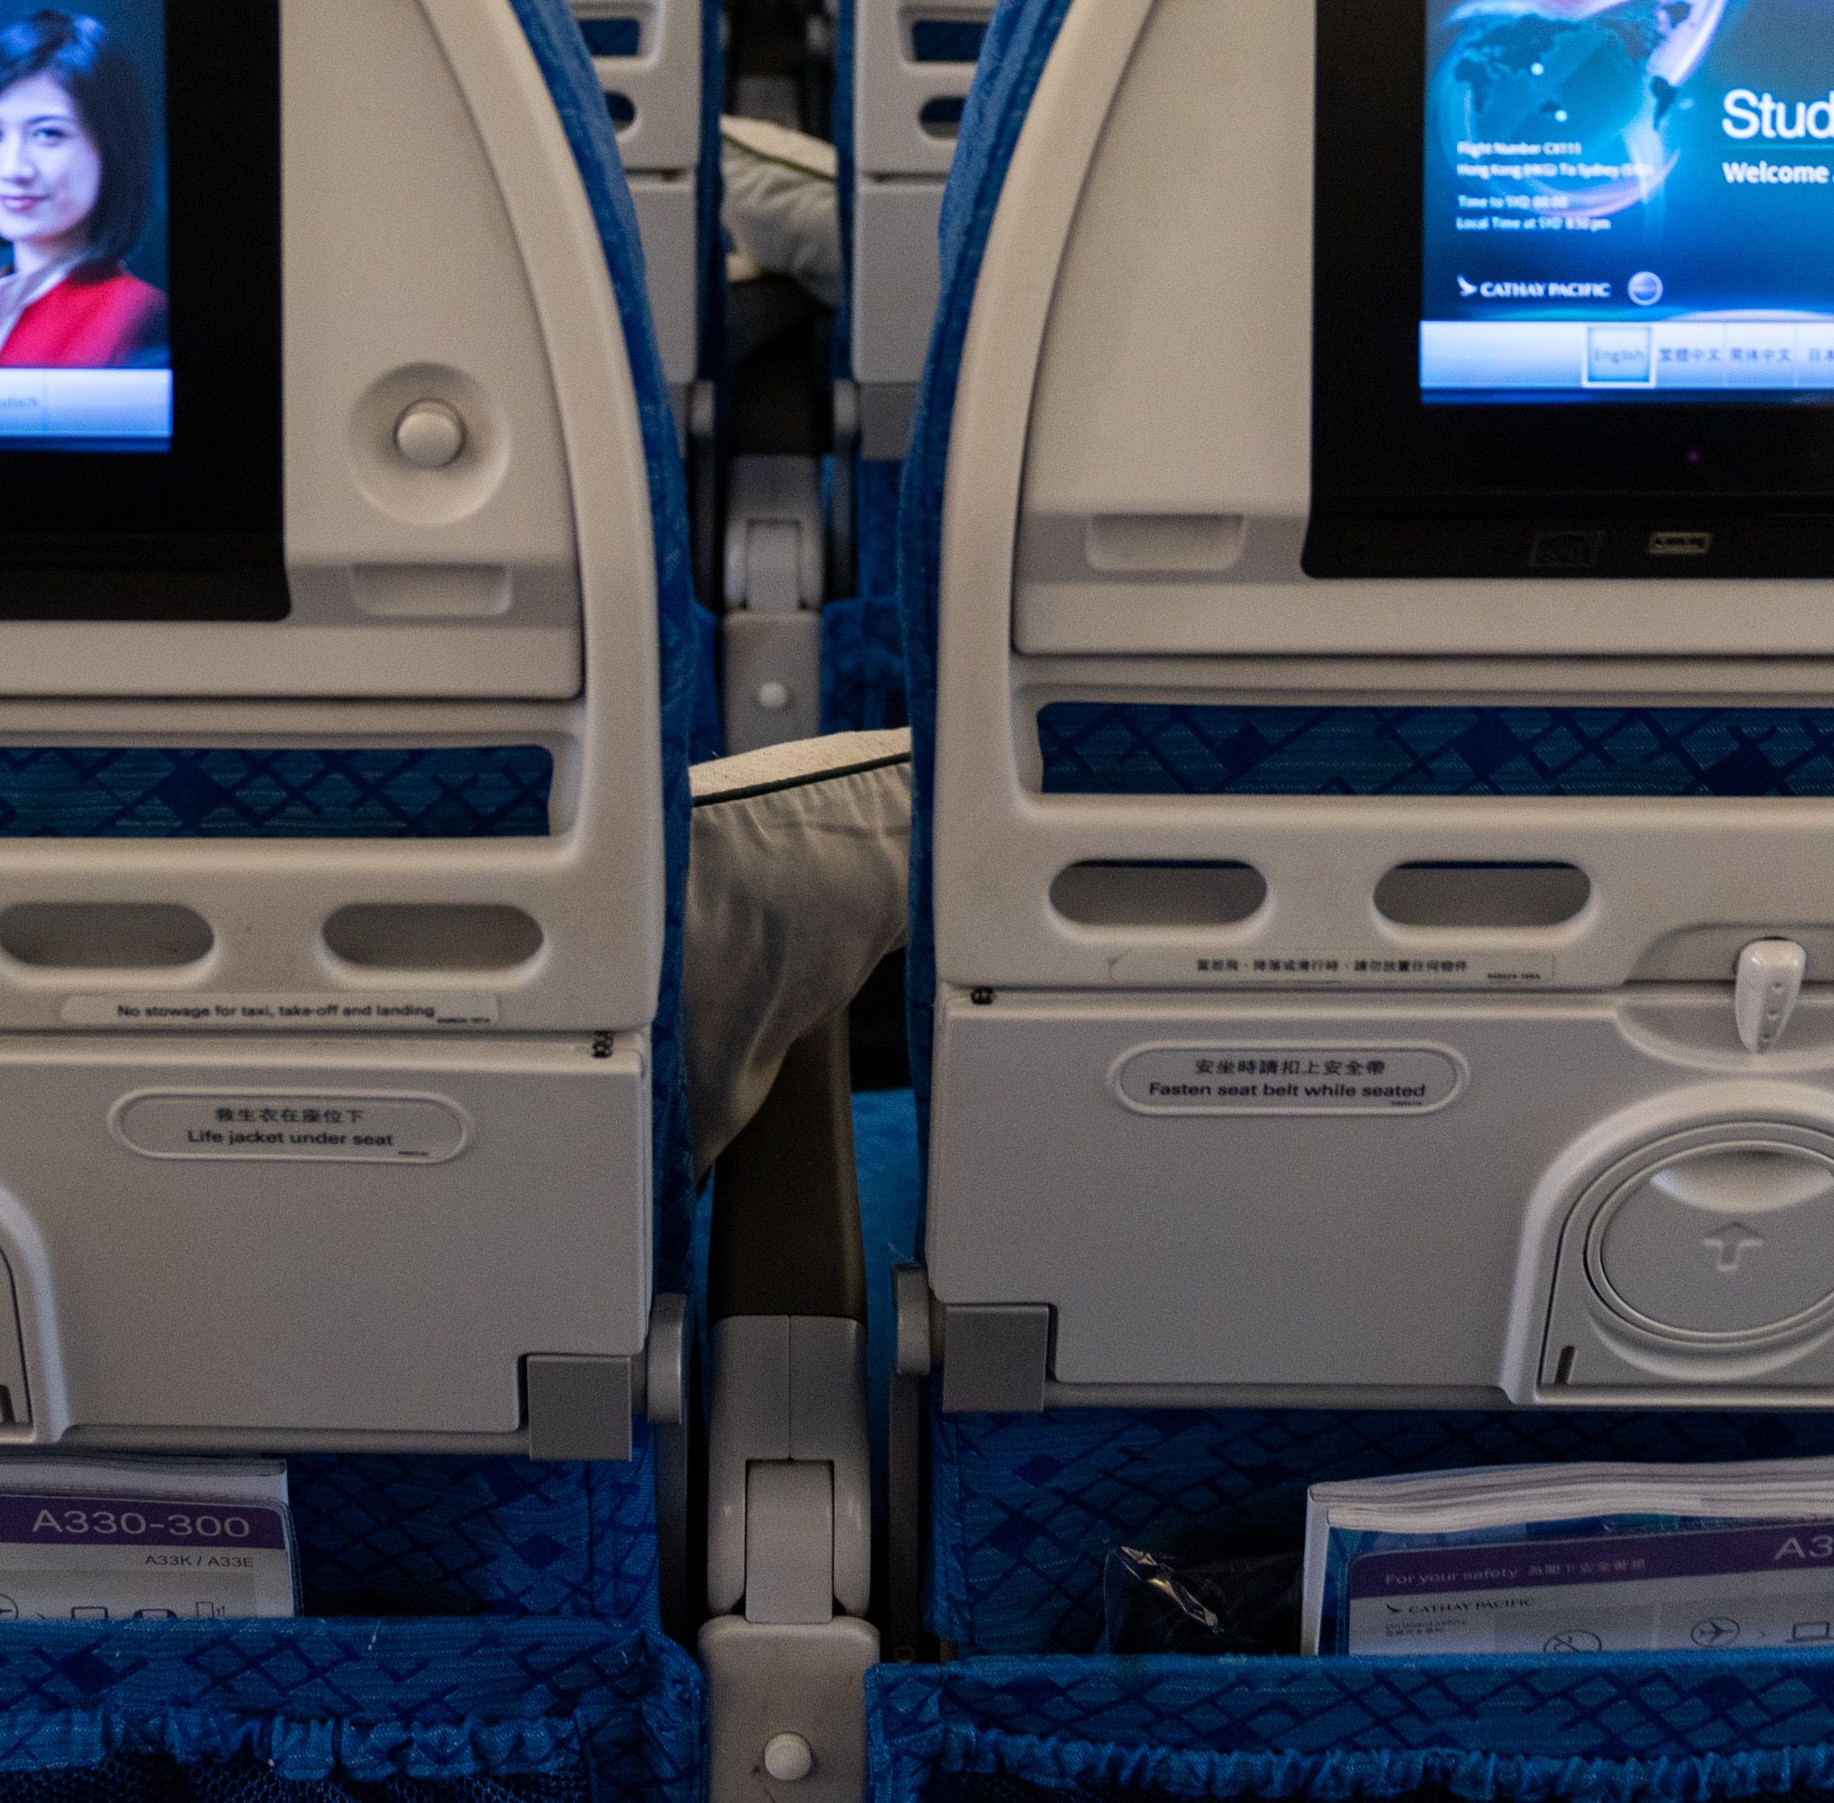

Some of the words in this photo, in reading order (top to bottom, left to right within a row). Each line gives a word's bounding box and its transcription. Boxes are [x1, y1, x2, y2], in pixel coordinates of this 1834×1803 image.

[1722, 161, 1829, 185] Welcome
[1480, 281, 1546, 298] CATHAY
[1548, 281, 1612, 298] PACIFIC
[116, 1005, 142, 1017] No
[144, 1006, 211, 1020] stowage
[214, 1004, 237, 1016] for
[278, 1004, 339, 1017] take-off
[342, 1005, 373, 1017] and
[375, 1004, 436, 1020] landing
[1149, 1081, 1210, 1097] Fasten
[1216, 1083, 1258, 1097] seat
[1262, 1082, 1299, 1097] belt
[1303, 1082, 1357, 1097] while
[1361, 1082, 1427, 1098] seated
[187, 1129, 225, 1144] Life
[228, 1130, 284, 1146] jacket
[290, 1132, 347, 1145] under
[352, 1133, 394, 1147] seat
[32, 1509, 250, 1538] A330-300
[144, 1555, 191, 1567] A33K
[207, 1556, 253, 1568] A33E
[1385, 1573, 1415, 1586] For
[1417, 1571, 1457, 1585] your
[1463, 1567, 1518, 1582] safety
